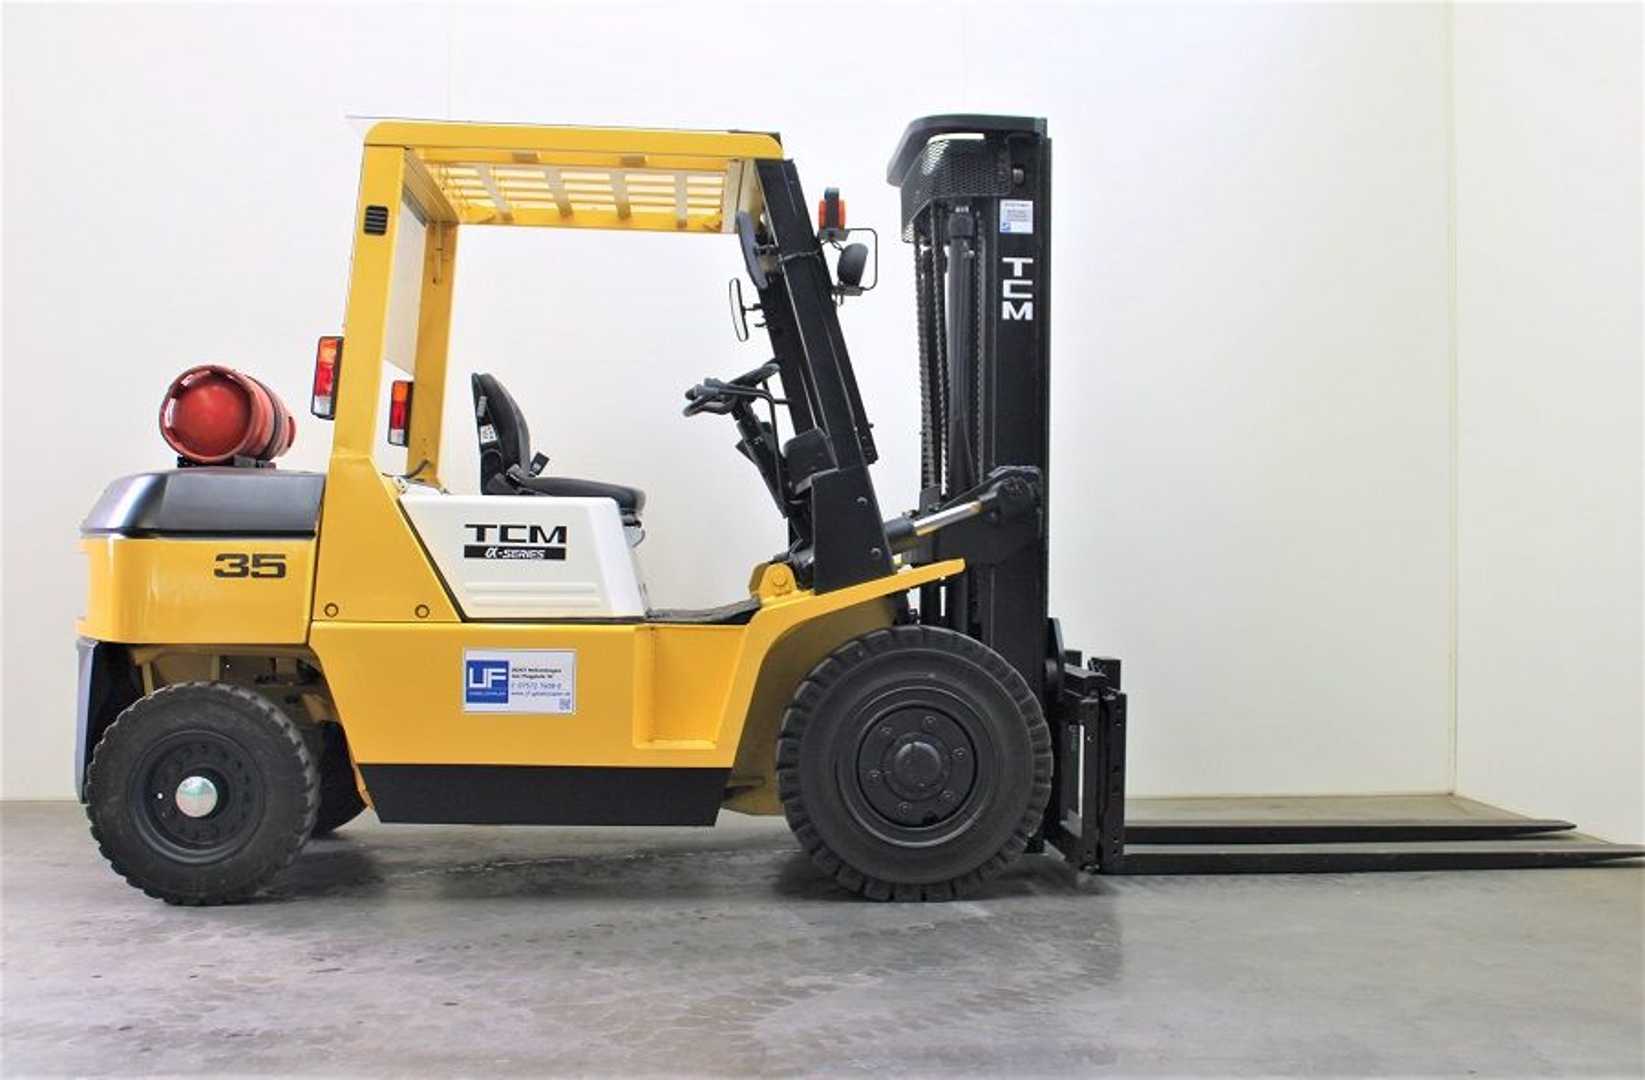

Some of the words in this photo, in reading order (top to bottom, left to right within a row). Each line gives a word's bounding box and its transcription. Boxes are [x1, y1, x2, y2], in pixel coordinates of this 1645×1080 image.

[1002, 257, 1033, 320] TCM
[464, 524, 567, 543] TCM
[213, 553, 287, 578] 35
[469, 668, 507, 688] UF
